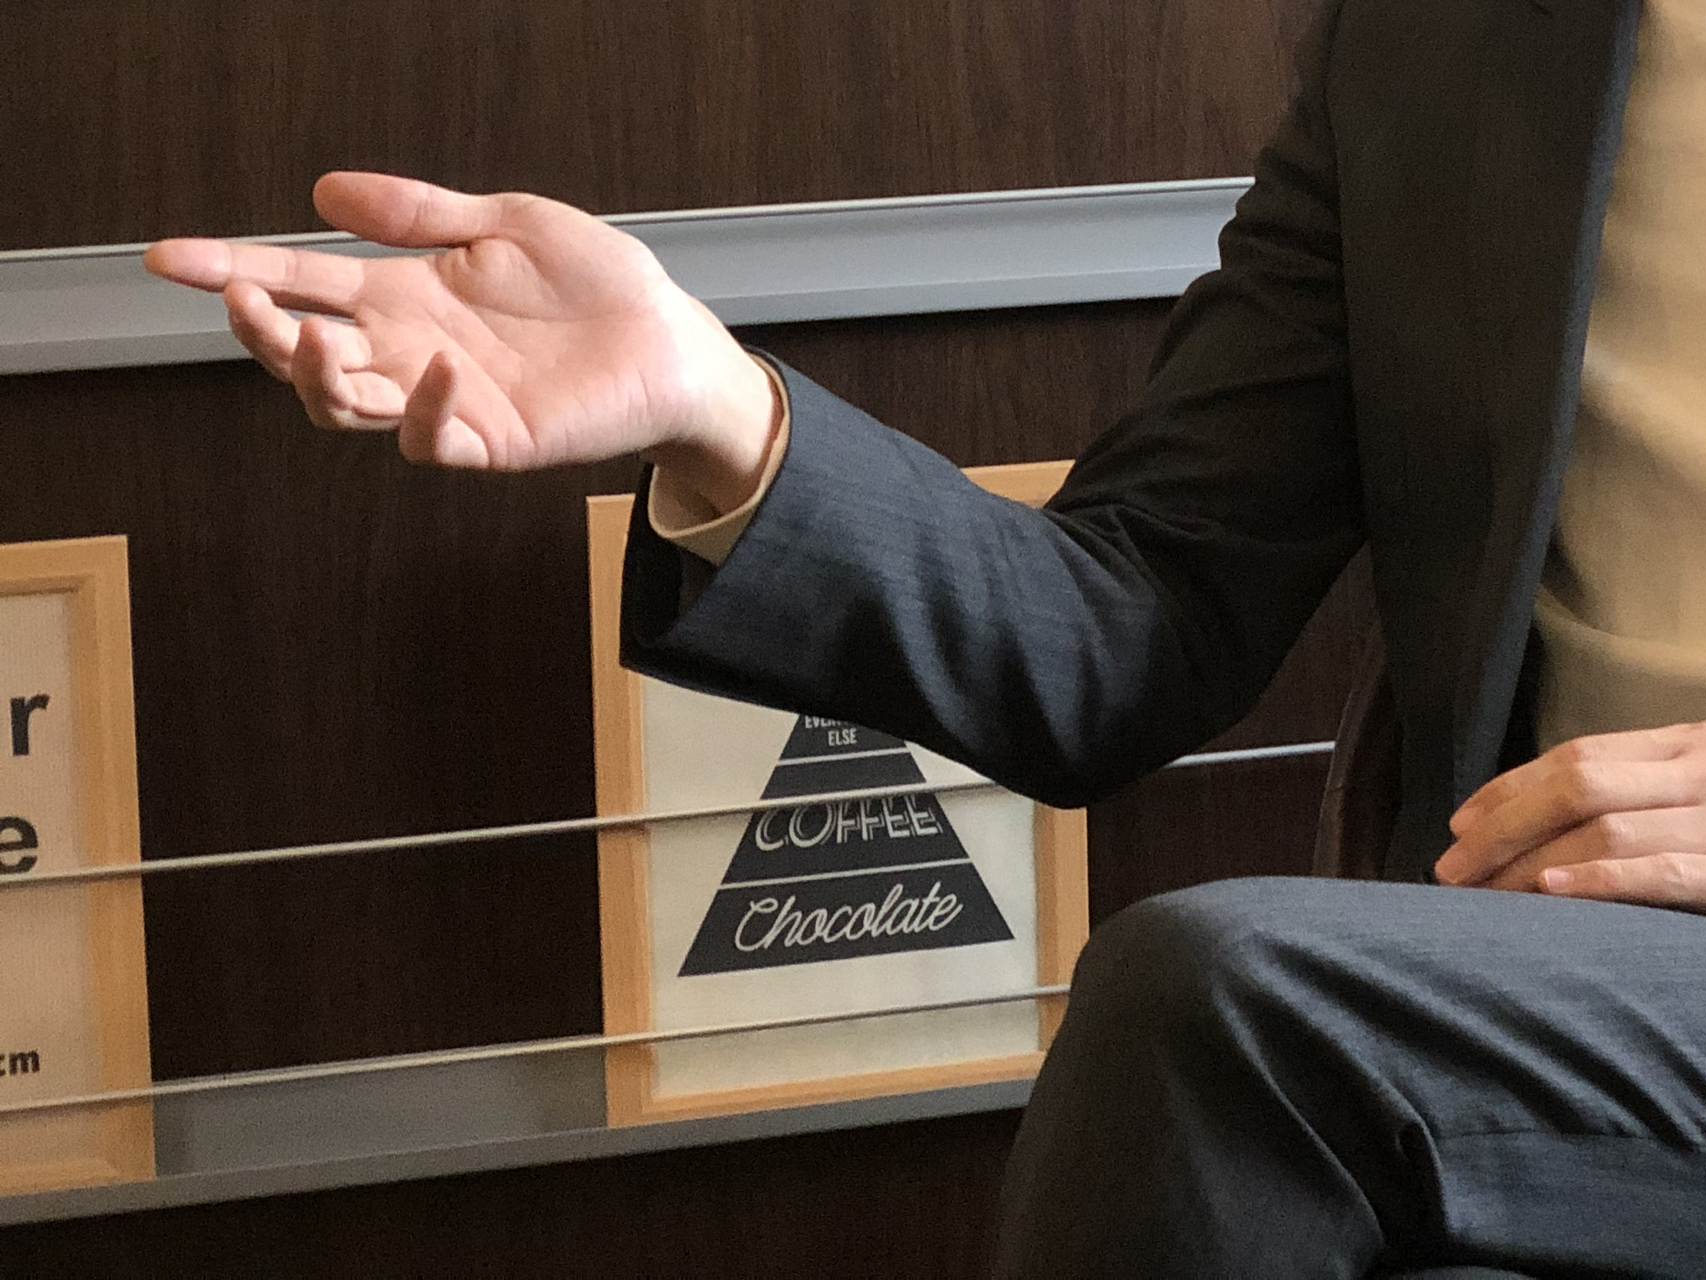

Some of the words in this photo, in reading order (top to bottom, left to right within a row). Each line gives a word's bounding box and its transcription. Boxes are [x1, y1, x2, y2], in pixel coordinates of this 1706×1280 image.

[827, 727, 858, 747] ELSE
[755, 791, 943, 852] COFFEE
[734, 880, 964, 952] Chocolate
